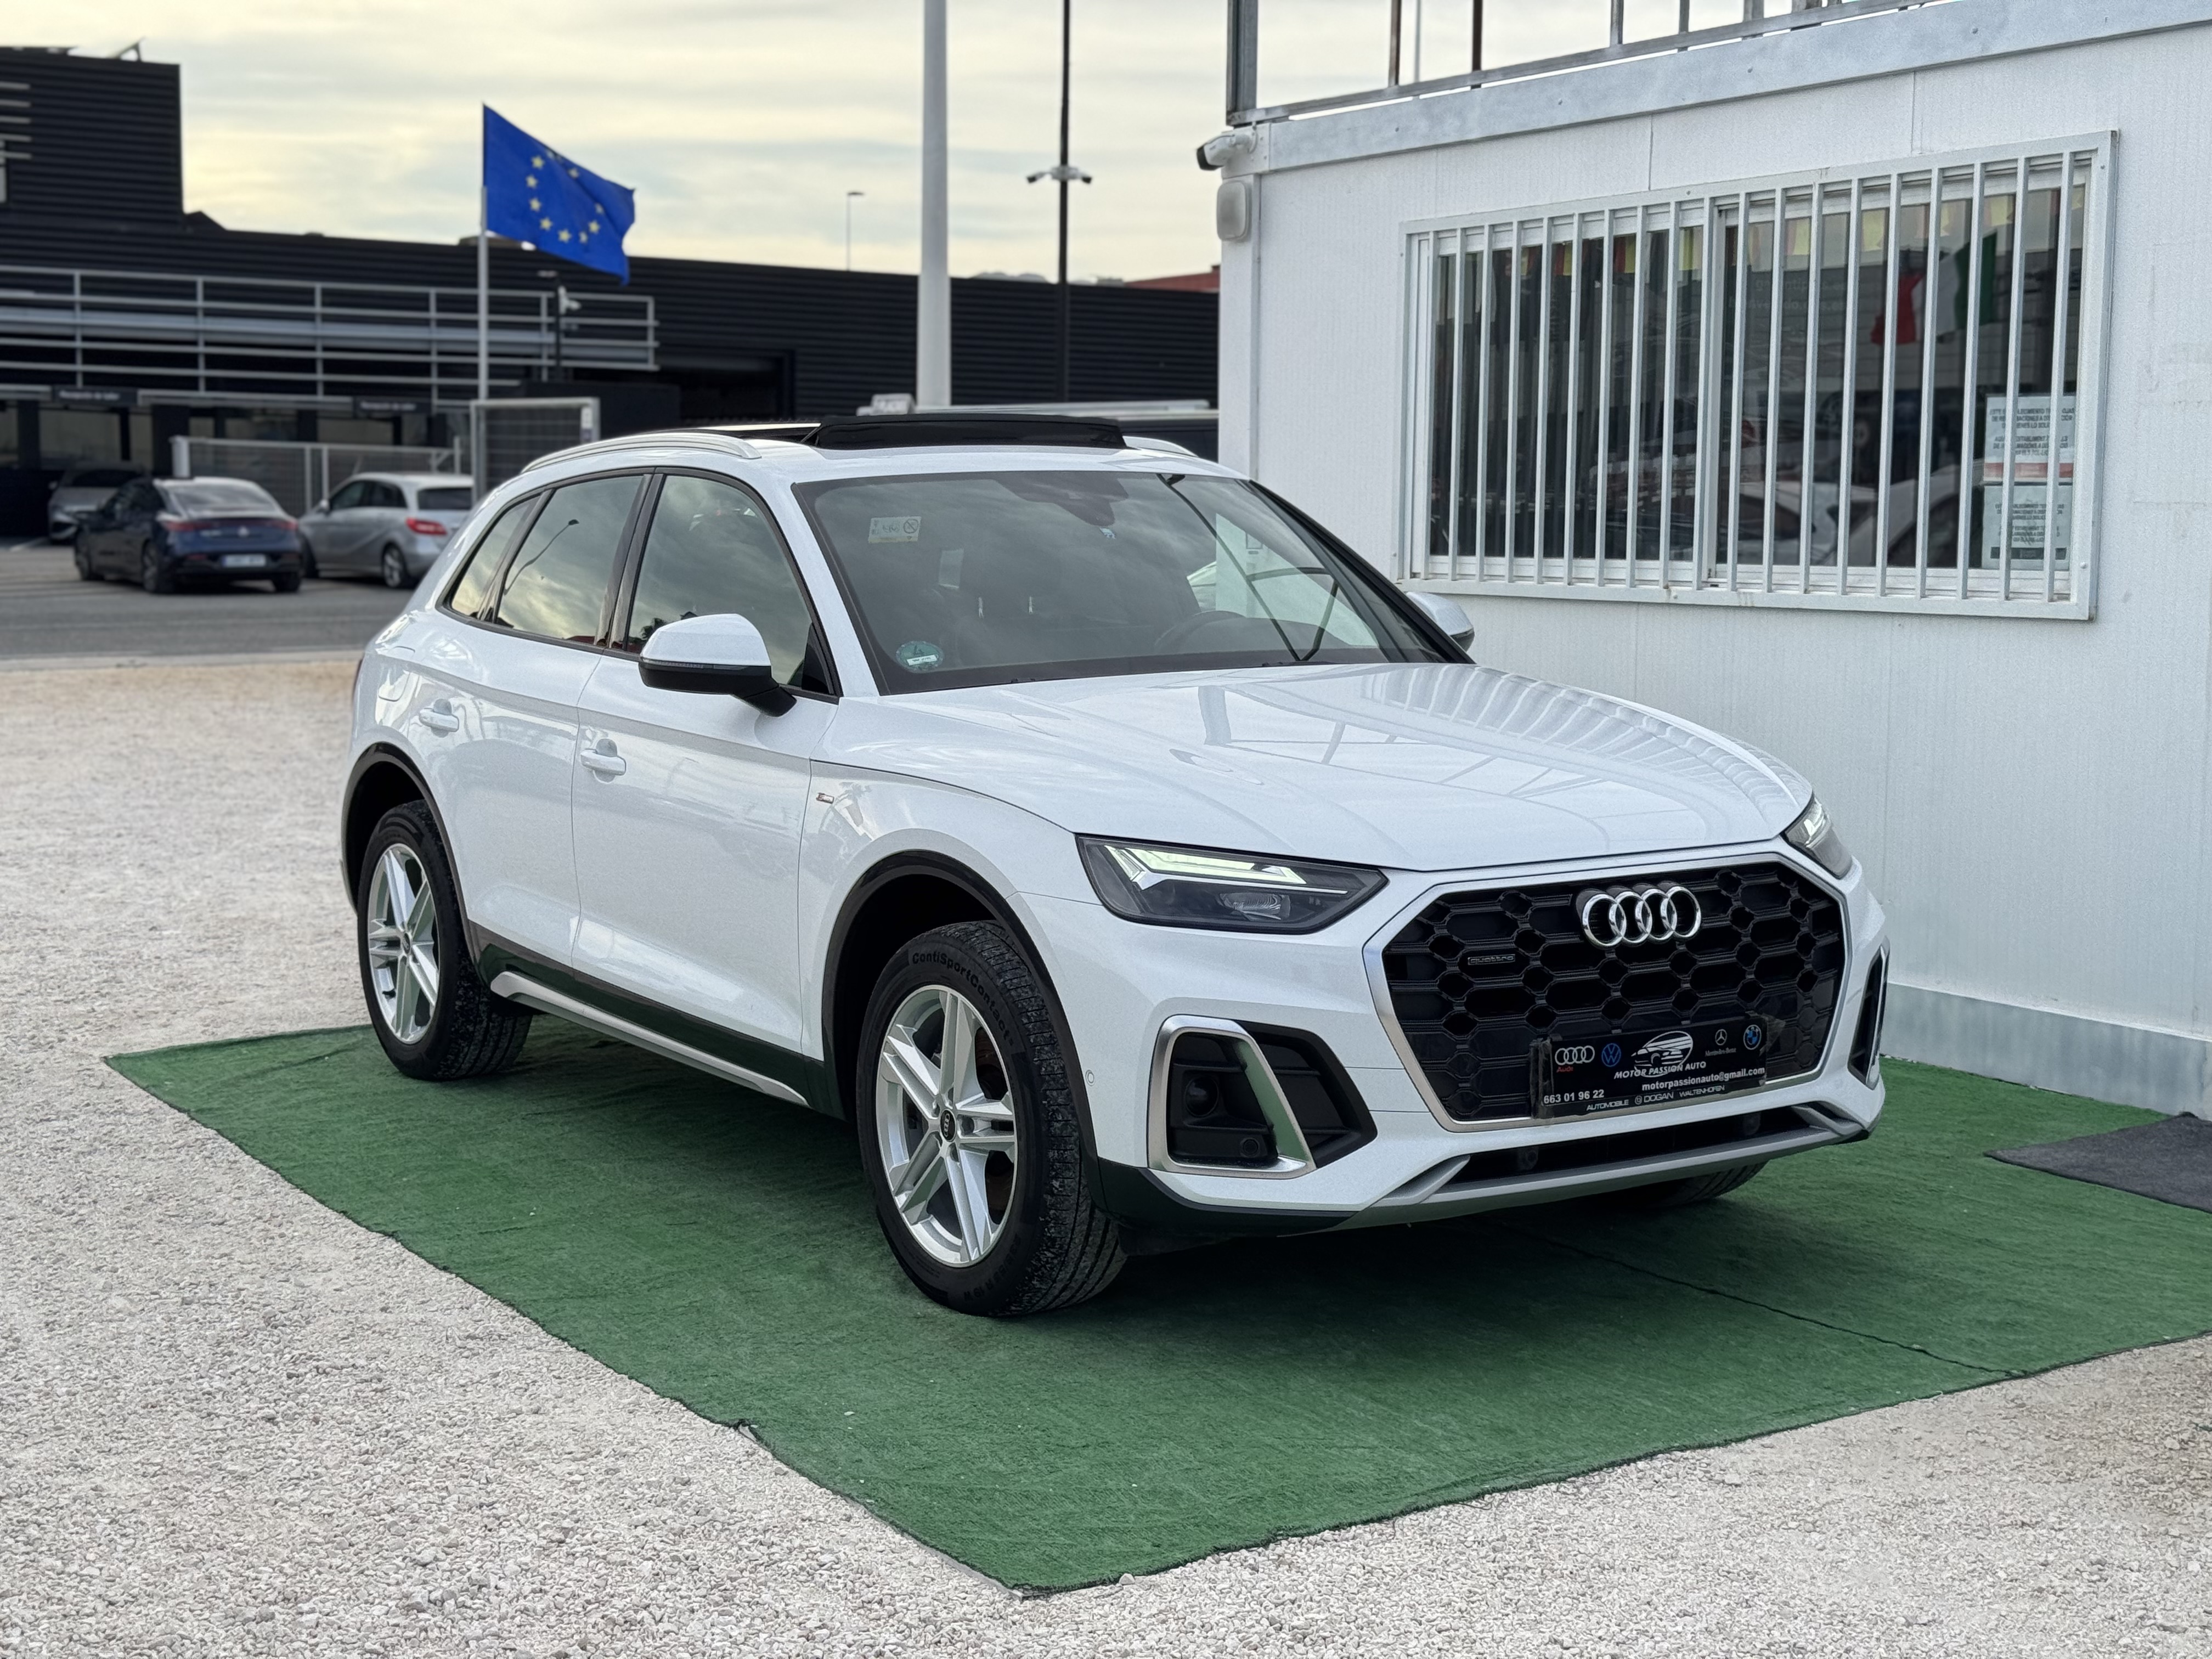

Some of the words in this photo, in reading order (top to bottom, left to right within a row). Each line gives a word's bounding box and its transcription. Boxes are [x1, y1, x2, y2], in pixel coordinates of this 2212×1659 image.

[912, 952, 1009, 1040] ContiSportContact
[1613, 1068, 1646, 1079] MOTOR
[1649, 1064, 1683, 1075] PASSION
[1685, 1061, 1707, 1070] AUTO
[1642, 1068, 1765, 1091] motorpassionauto@gmail.com
[1543, 1094, 1561, 1104] 663
[1564, 1092, 1575, 1102] 01
[1578, 1091, 1590, 1101] 96
[1592, 1089, 1605, 1099] 22
[1586, 1099, 1629, 1111] AUTOMOBILE
[1644, 1091, 1674, 1103] DOGAN
